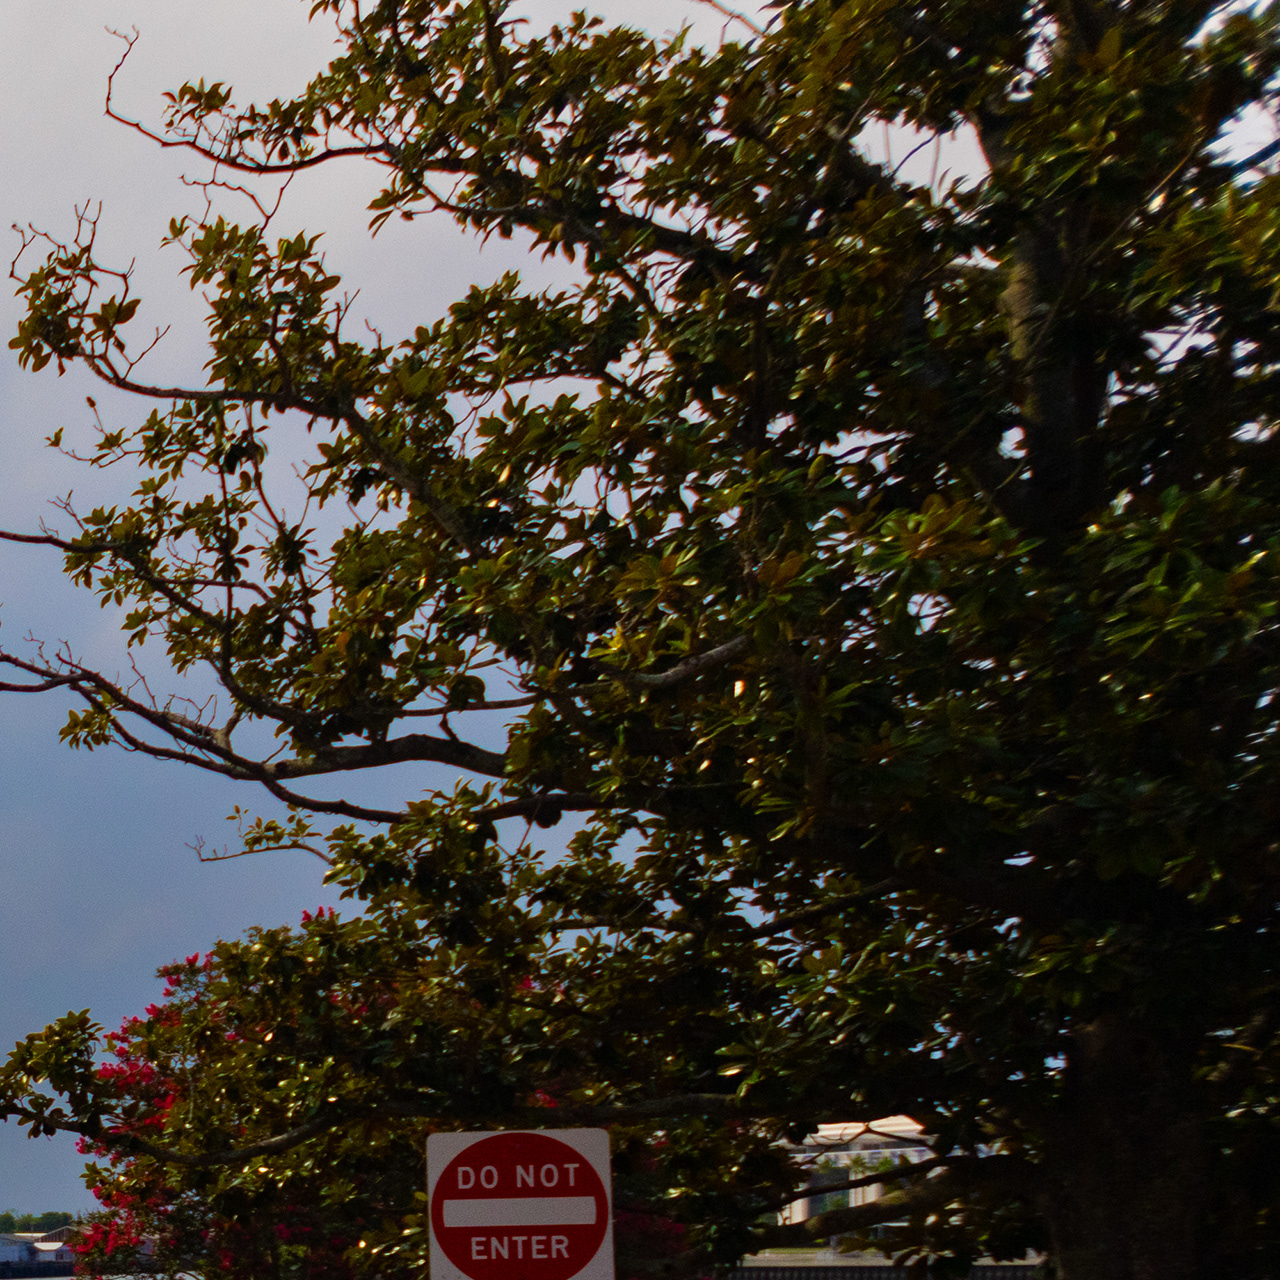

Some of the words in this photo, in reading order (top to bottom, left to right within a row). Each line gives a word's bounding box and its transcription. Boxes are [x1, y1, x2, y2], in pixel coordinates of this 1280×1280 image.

[456, 1166, 499, 1190] DO
[516, 1163, 581, 1188] NOT
[470, 1235, 570, 1261] ENTER
